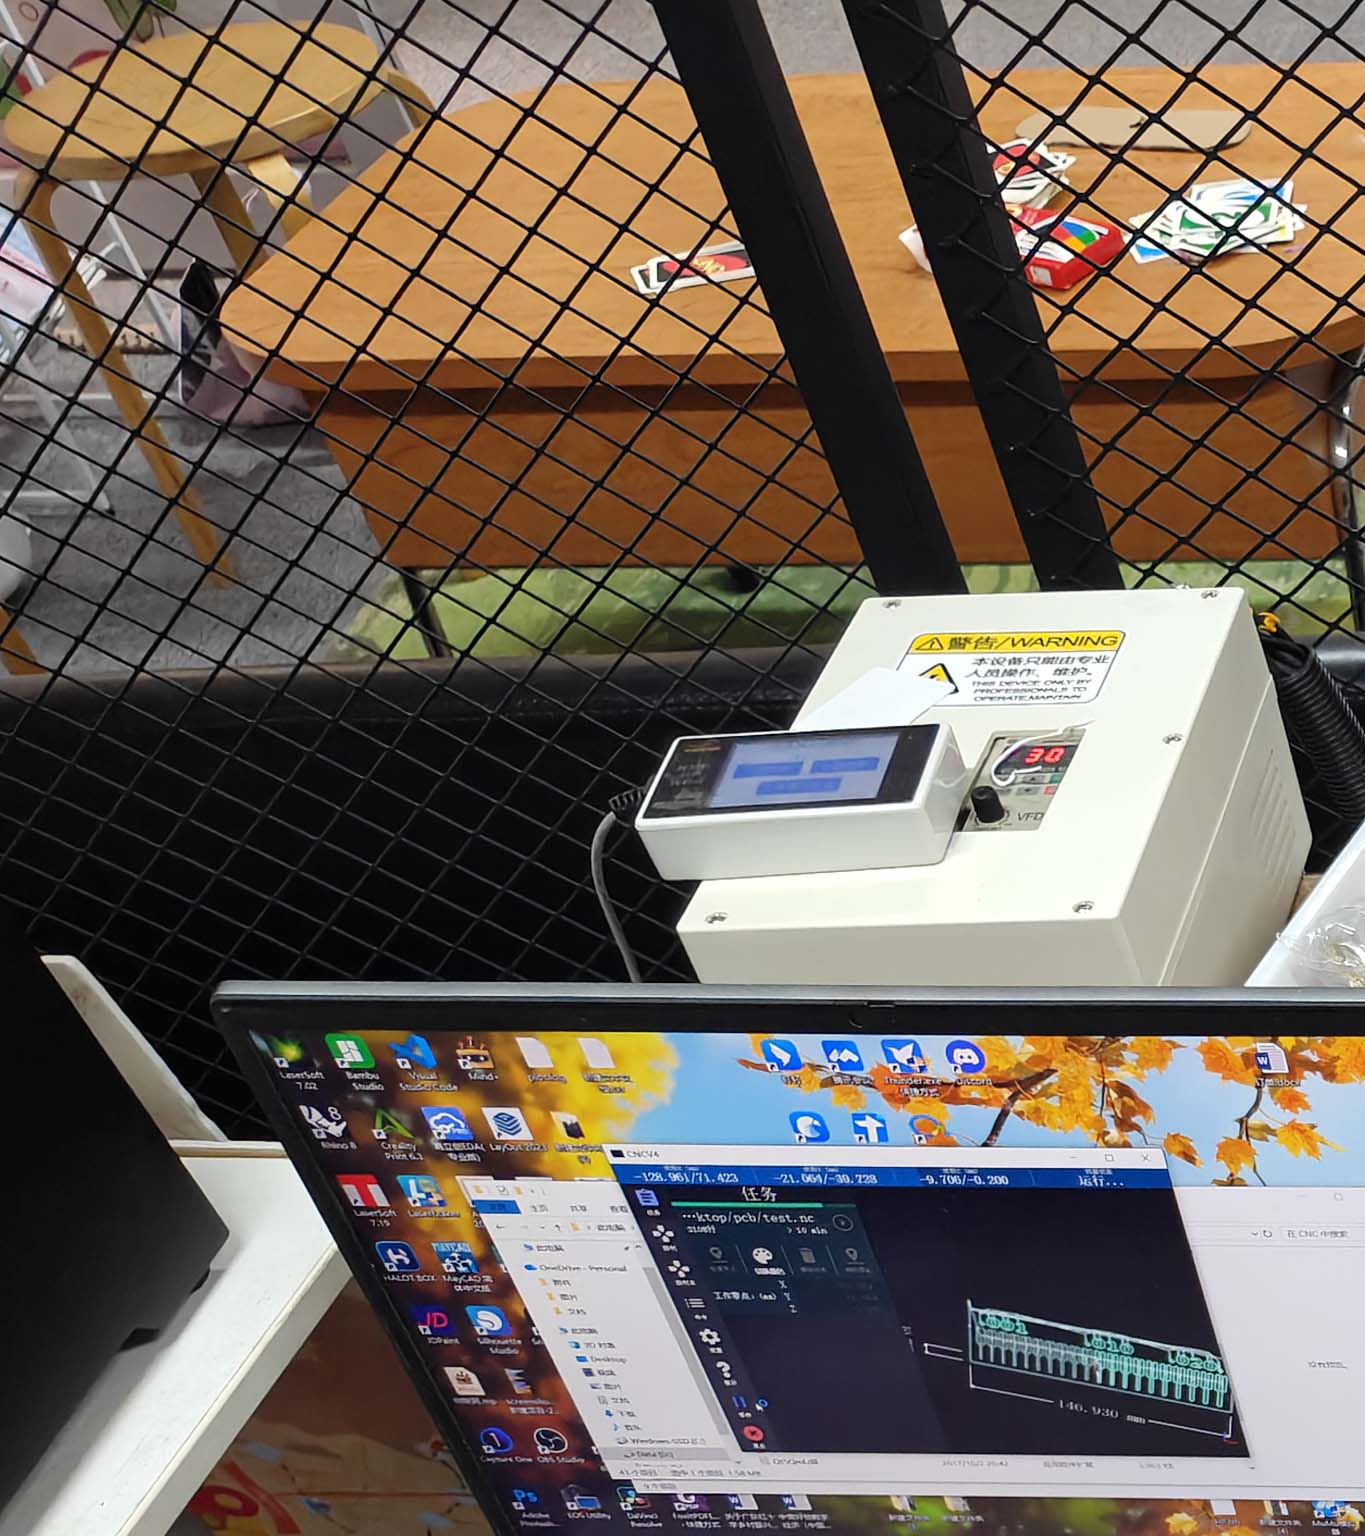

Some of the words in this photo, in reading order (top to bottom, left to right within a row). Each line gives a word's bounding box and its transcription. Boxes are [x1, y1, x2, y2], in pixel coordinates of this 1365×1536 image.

[947, 636, 1118, 650] 警告/WARNING
[972, 655, 1110, 665] 本设备只能由专业
